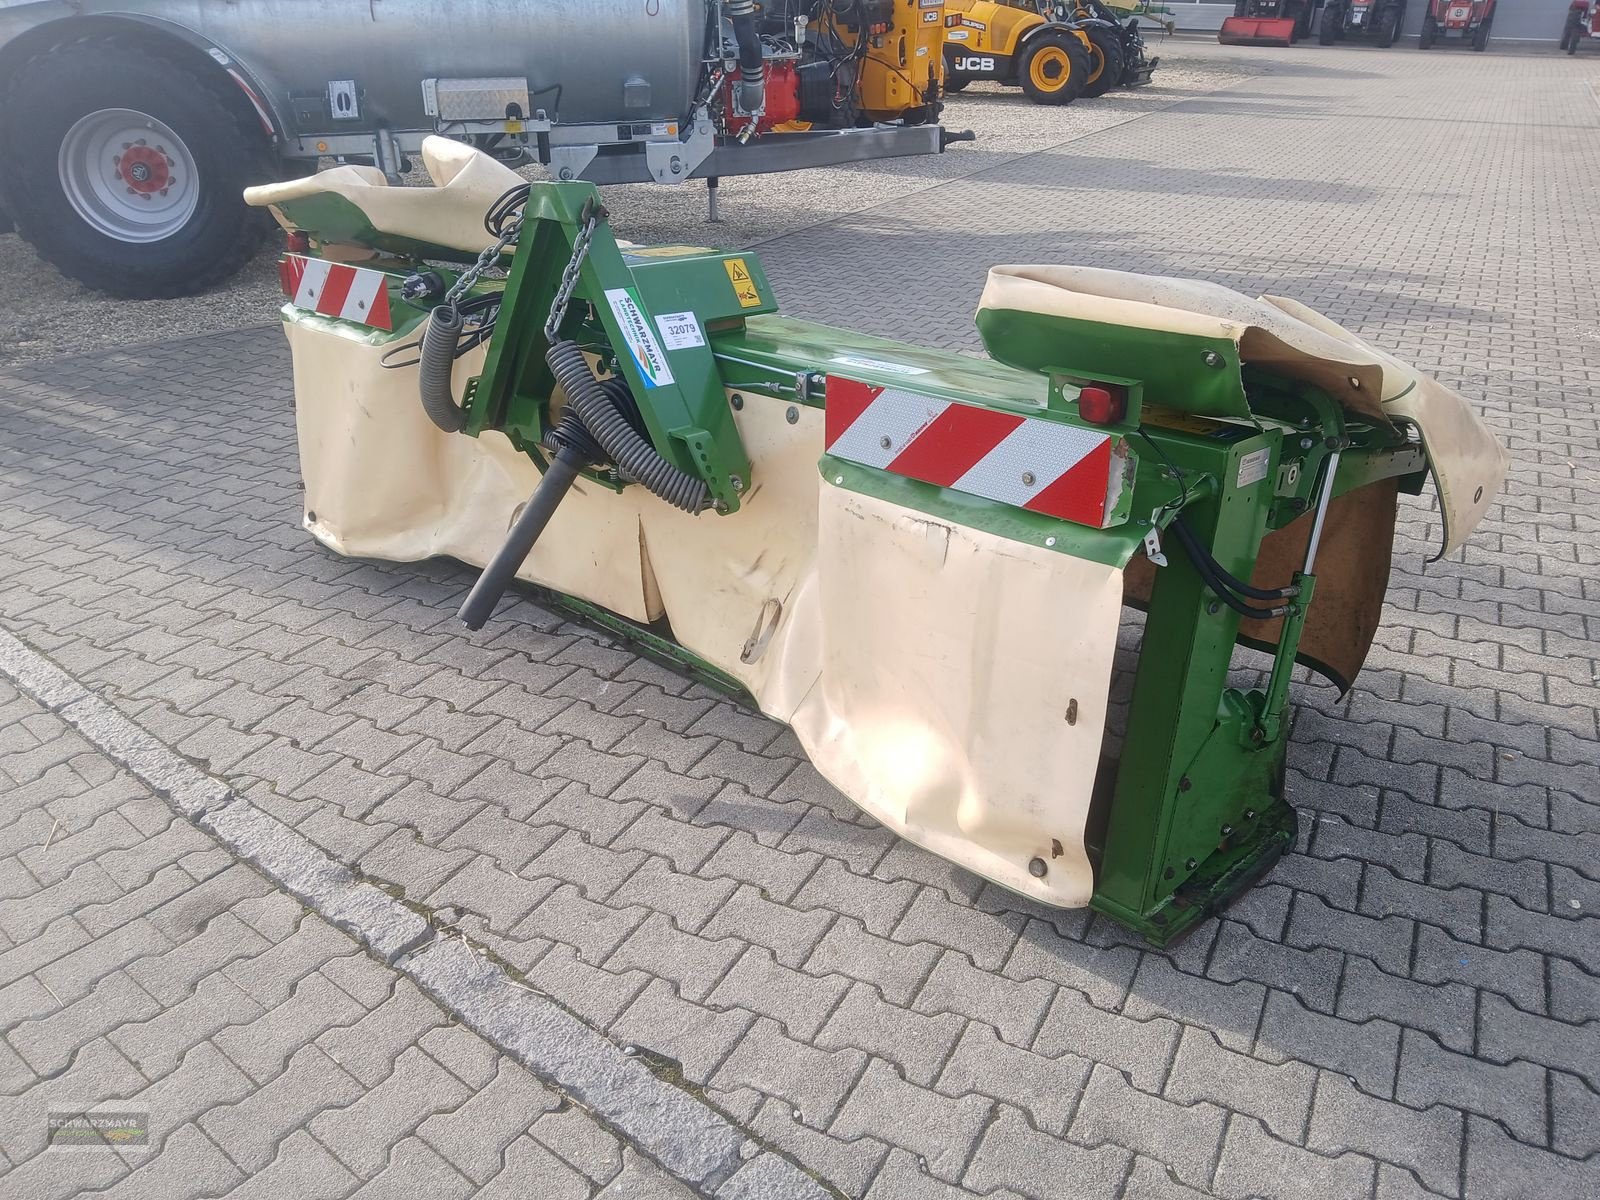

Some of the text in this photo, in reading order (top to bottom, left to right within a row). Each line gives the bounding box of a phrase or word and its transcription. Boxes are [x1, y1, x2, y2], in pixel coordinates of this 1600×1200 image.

[924, 12, 938, 22] JCB
[955, 57, 995, 71] JCB
[619, 299, 641, 343] LANDTECHNIK
[624, 297, 661, 372] SCHWARZMAYR
[668, 323, 696, 335] 32079
